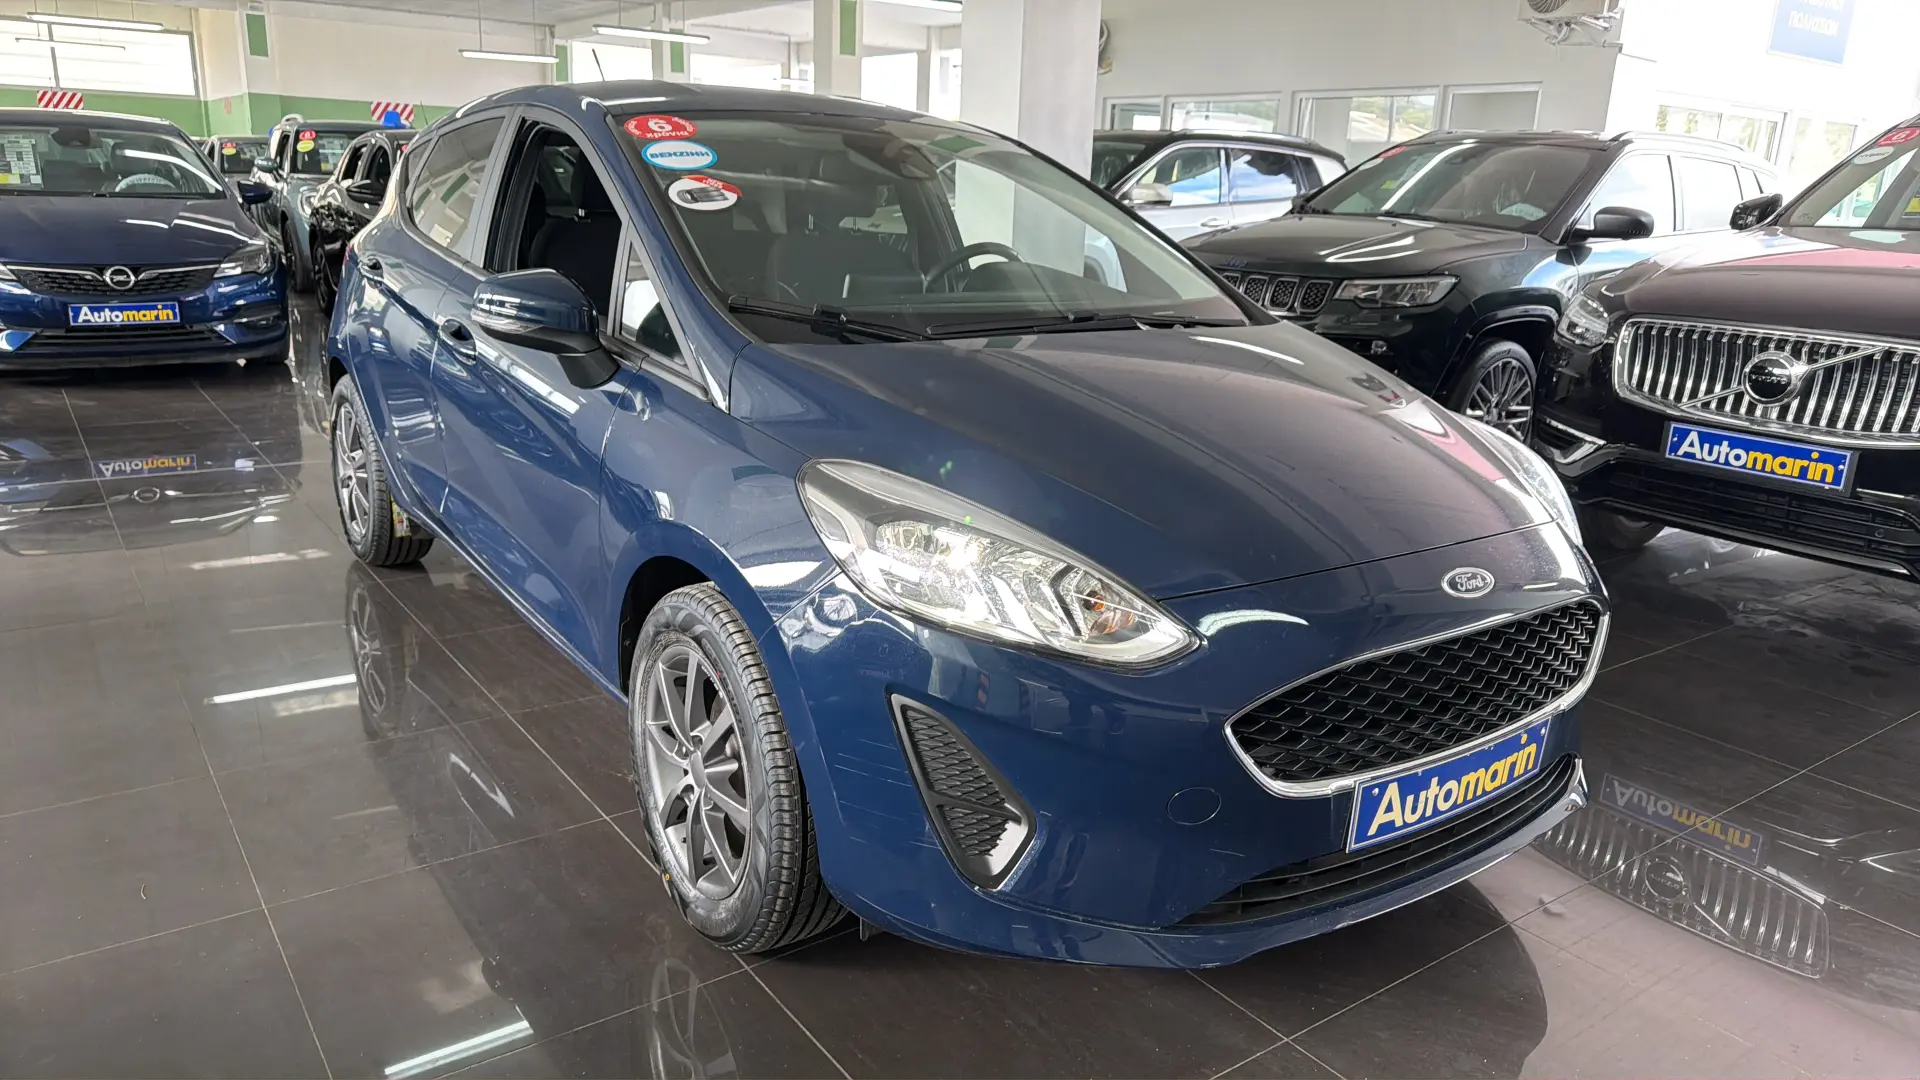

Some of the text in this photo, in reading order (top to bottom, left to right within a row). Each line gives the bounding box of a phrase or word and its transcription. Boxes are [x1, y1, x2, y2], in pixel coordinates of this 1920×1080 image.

[648, 119, 672, 132] 6
[78, 304, 174, 323] Automarin
[1676, 431, 1835, 483] Automarin
[1455, 573, 1487, 591] Ford
[1367, 733, 1537, 836] Automarin
